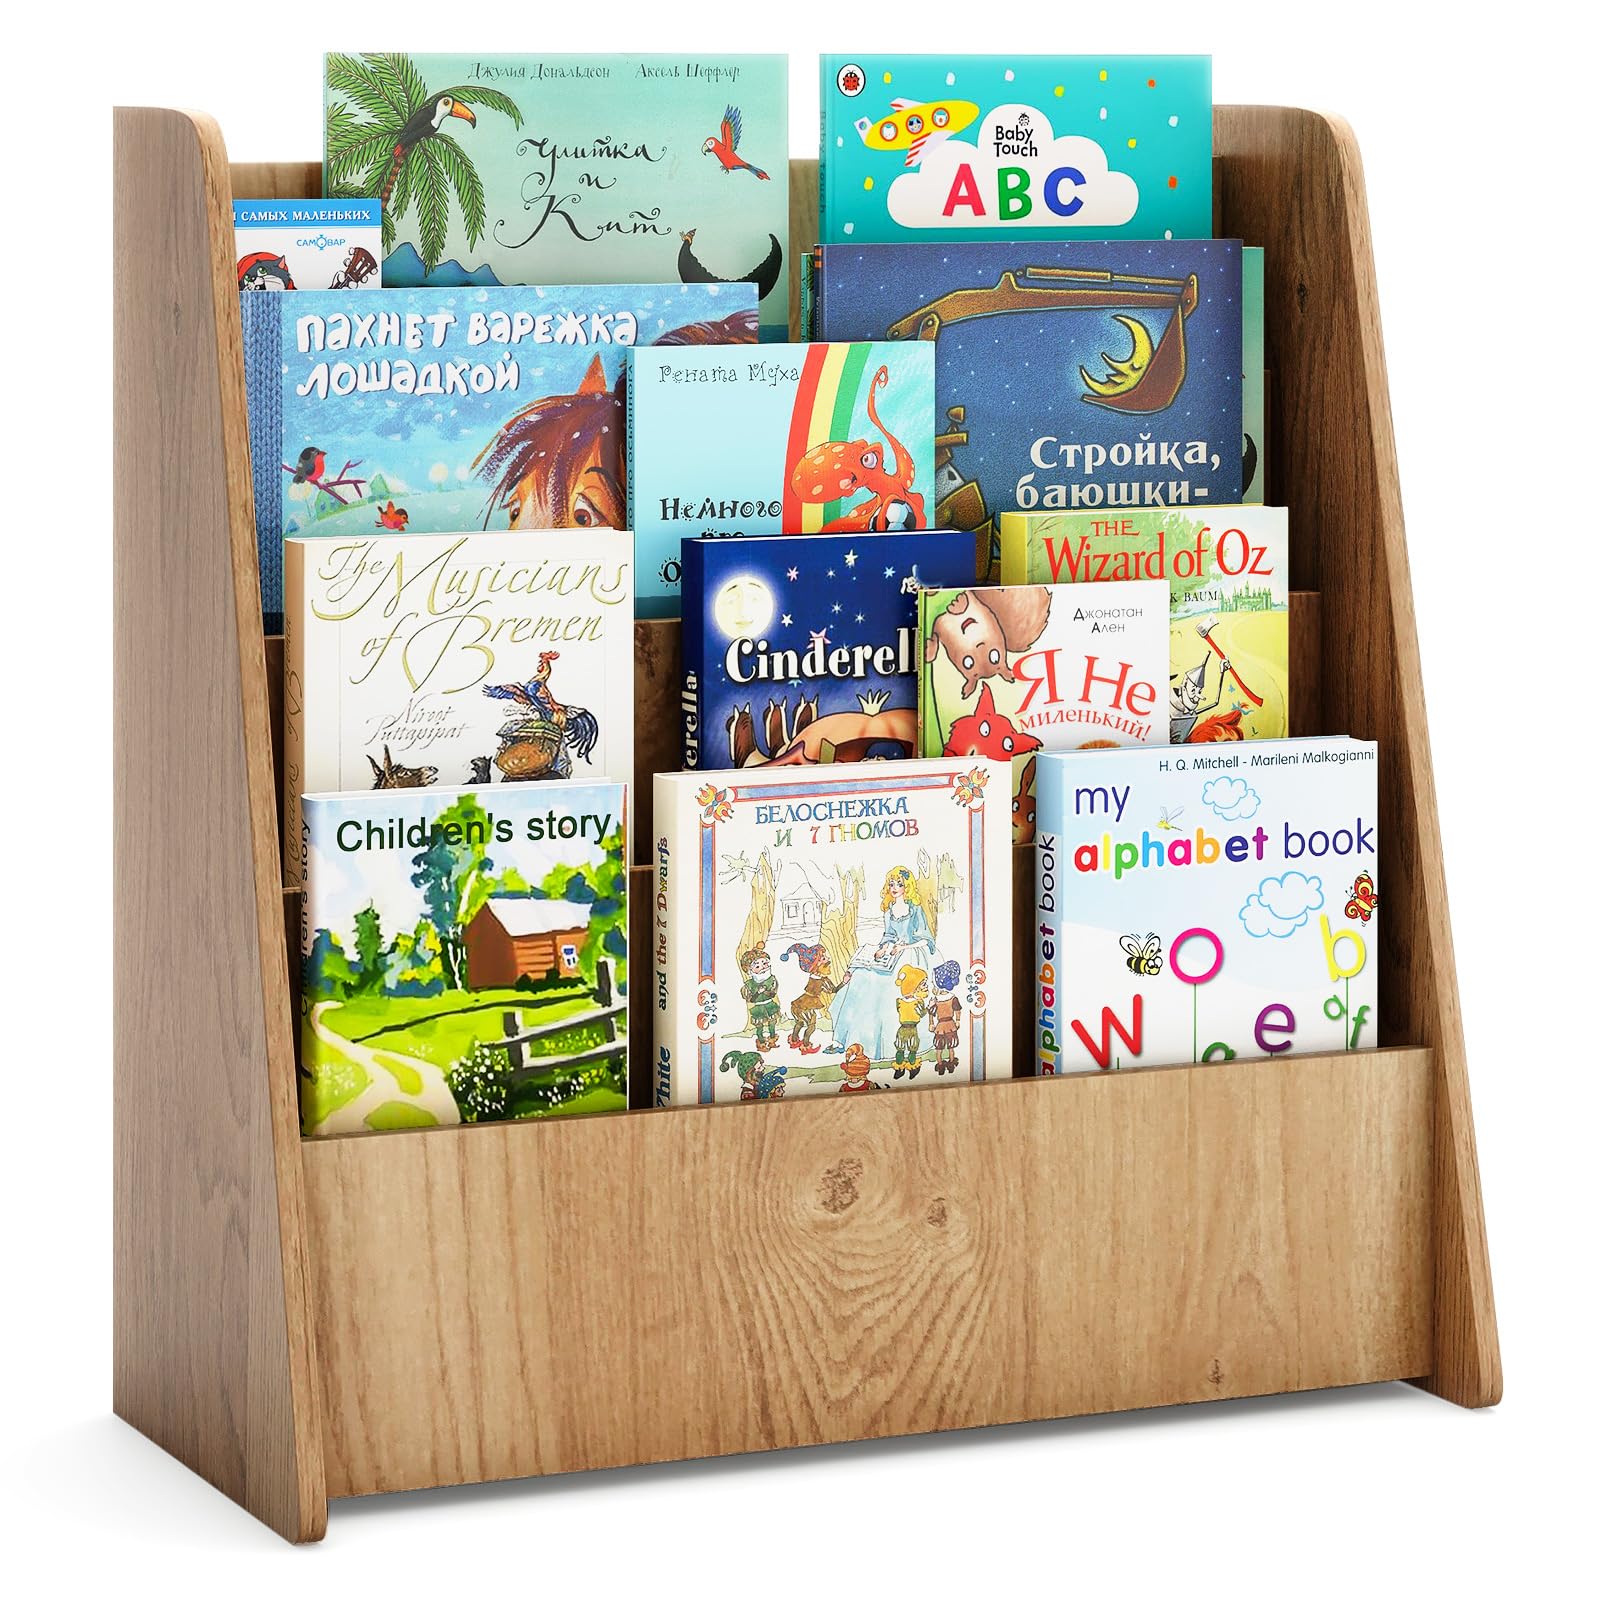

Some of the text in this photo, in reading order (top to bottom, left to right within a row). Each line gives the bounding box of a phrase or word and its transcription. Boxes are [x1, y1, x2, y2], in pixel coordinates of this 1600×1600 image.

[993, 142, 1038, 158] Touch
[995, 125, 1034, 145] Baby
[517, 136, 667, 203] Улитка
[942, 164, 1087, 220] ABC
[241, 211, 288, 222] САМЫХ
[292, 210, 372, 221] МАЛЕНЬКИХ
[494, 194, 672, 249] Кит
[659, 361, 800, 387] Рената Муха
[1029, 433, 1222, 479] Стройка,
[1015, 473, 1209, 509] баюшки-
[1090, 520, 1140, 537] THE
[319, 540, 392, 603] The
[1042, 527, 1275, 584] Wizard of Oz
[311, 537, 628, 621] Musicians
[1184, 591, 1218, 602] BAUM
[1073, 607, 1143, 622] Джонатан
[1091, 621, 1125, 634] Ален
[350, 600, 603, 694] of Bremen
[725, 627, 918, 683] Cinderell
[1012, 649, 1064, 716] Я
[681, 673, 698, 768] erella
[1159, 760, 1172, 772] H.
[1176, 759, 1189, 771] Q.
[1193, 755, 1239, 770] Mitchell
[1251, 753, 1299, 767] Marileni
[1302, 749, 1374, 765] Malkogianni
[755, 797, 909, 825] БЕЛОСНЕЖКА
[1074, 785, 1130, 822] my
[336, 809, 611, 852] Children's story
[809, 826, 819, 844] 7
[829, 819, 919, 844] ГНОМОВ
[1074, 817, 1376, 880] alphabet book
[1038, 834, 1056, 913] book
[657, 933, 668, 970] the
